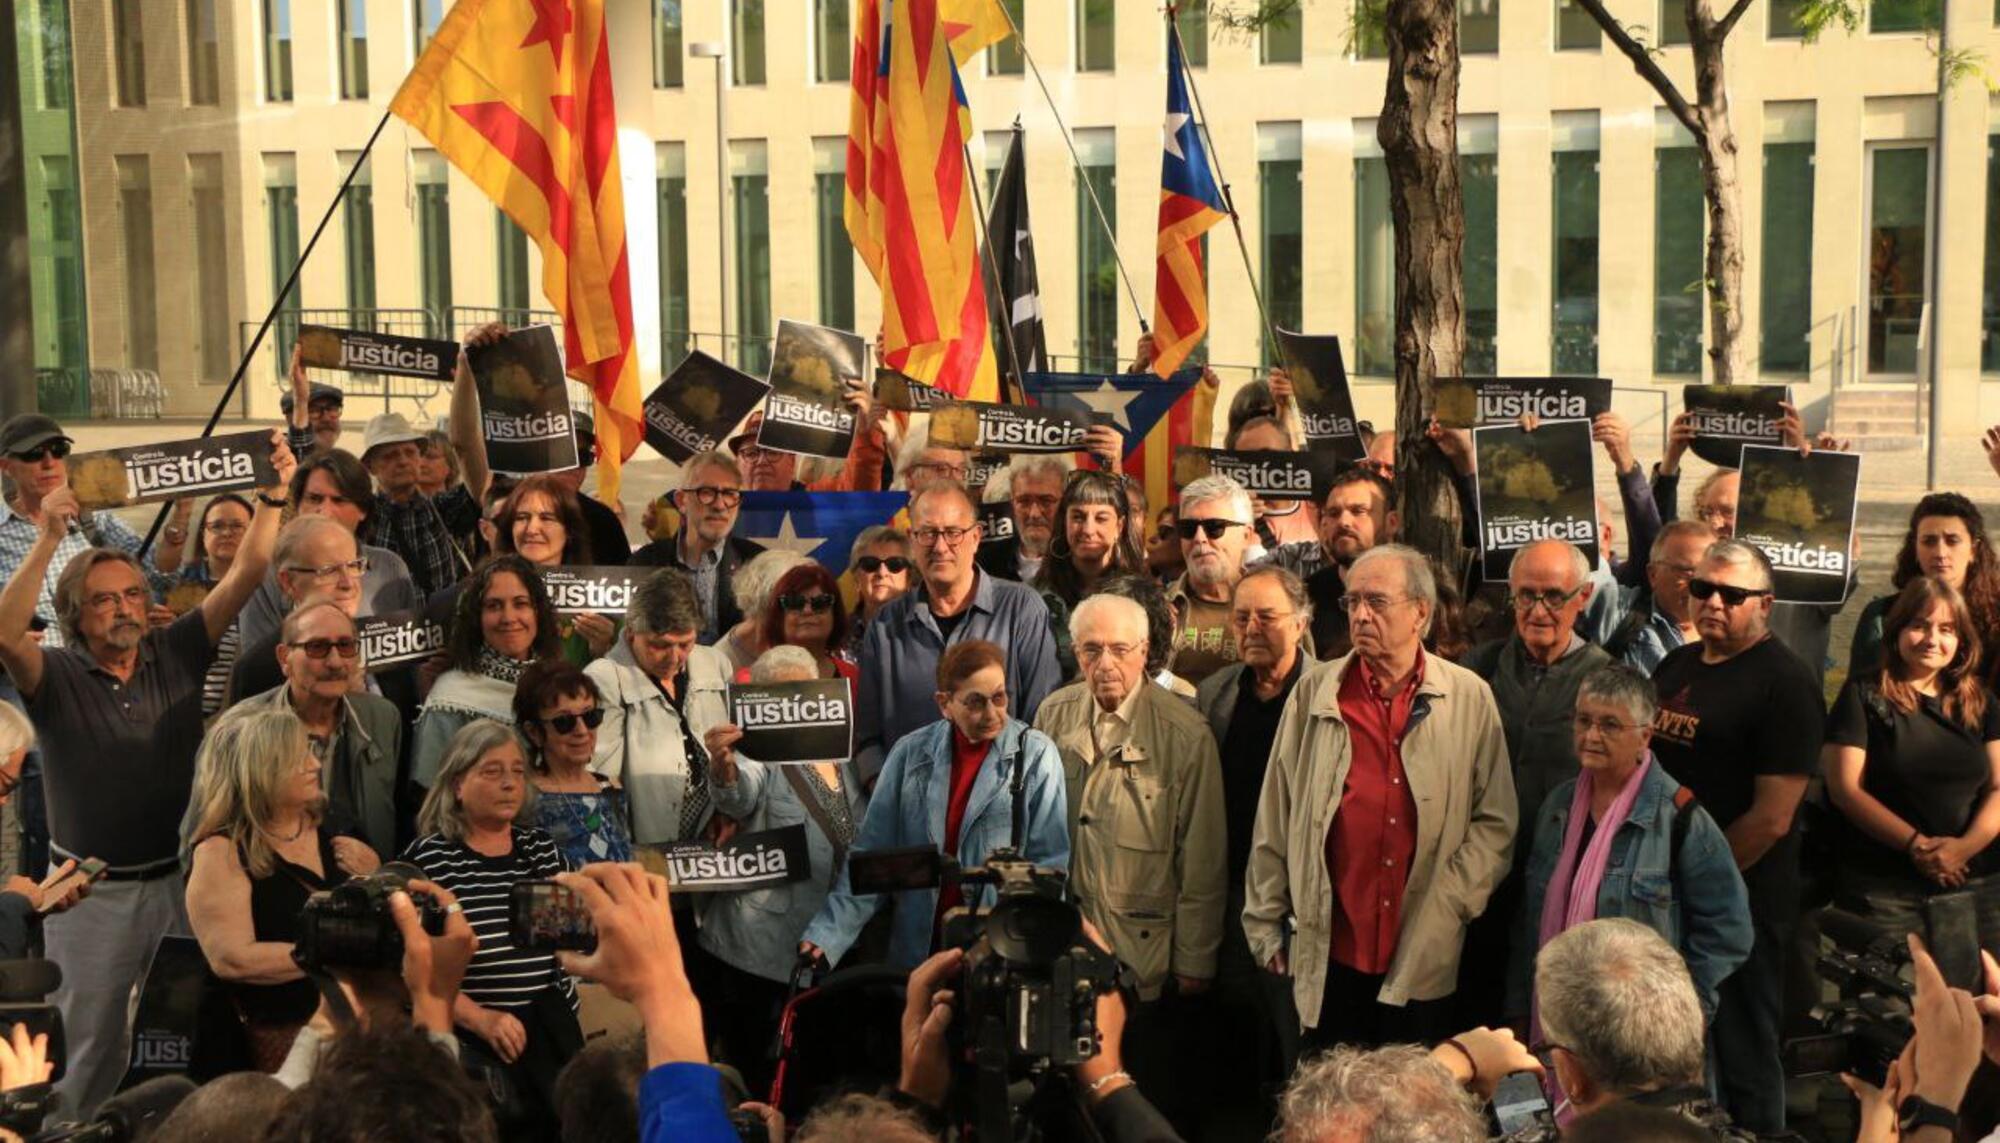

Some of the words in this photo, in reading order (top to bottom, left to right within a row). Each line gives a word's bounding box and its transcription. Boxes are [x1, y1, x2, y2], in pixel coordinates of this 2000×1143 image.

[339, 339, 438, 370] justícia
[767, 397, 852, 429] justícia
[1475, 389, 1586, 423] justícia
[485, 412, 568, 440] justícia
[975, 414, 1088, 446] justícia
[126, 448, 254, 499] justícia
[1487, 516, 1593, 551] justícia
[1760, 542, 1844, 569] stícia
[546, 578, 638, 607] ustíci
[359, 619, 443, 669] justícia
[736, 693, 845, 729] justícia
[1653, 709, 1699, 738] NTS
[666, 844, 787, 885] justícia
[133, 1033, 191, 1069] just
